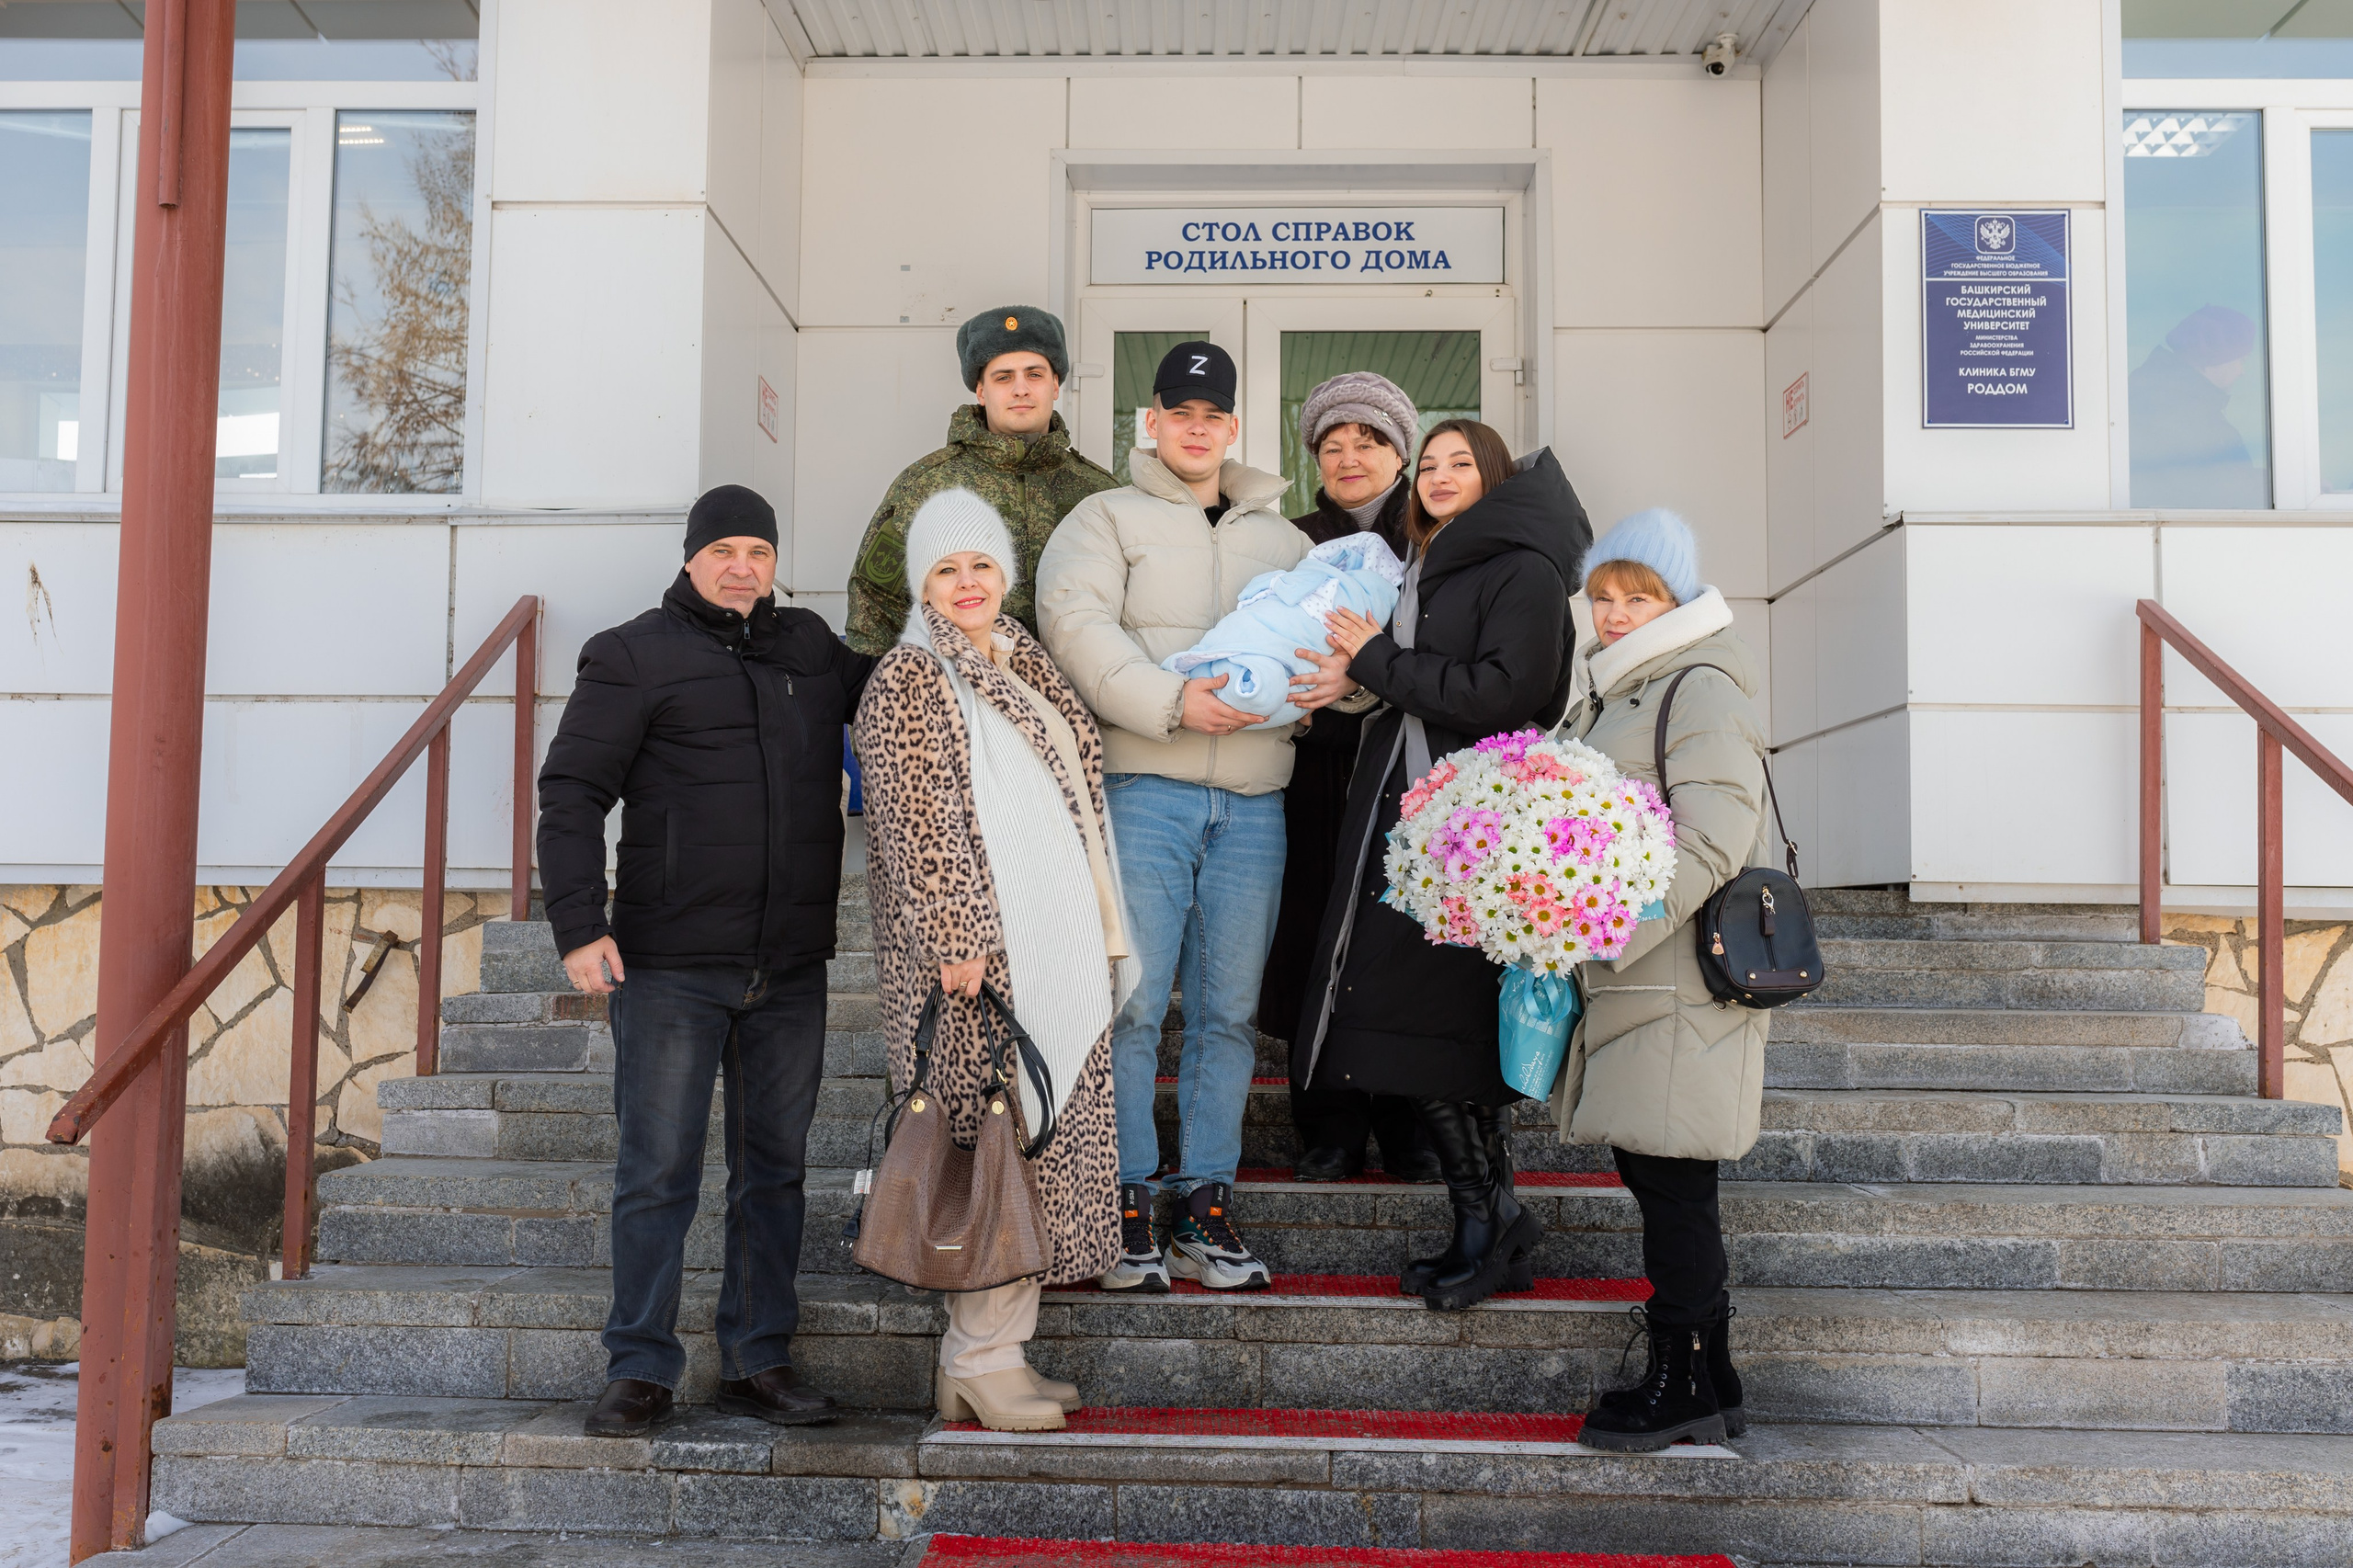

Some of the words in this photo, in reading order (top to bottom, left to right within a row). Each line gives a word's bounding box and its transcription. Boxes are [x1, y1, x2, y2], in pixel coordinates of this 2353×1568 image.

[1181, 222, 1263, 242] СТОЛ
[1271, 222, 1415, 242] СПРАВОК
[1145, 250, 1351, 273] РОДИЛЬНОГО
[1360, 250, 1452, 273] ДОМА
[1961, 284, 2031, 295] БАШКИРСКИЙ
[1946, 296, 2047, 308] ГОСУДАРСТВЕННЫЙ
[1957, 308, 2036, 319] МЕДИЦИНСКИЙ
[1963, 321, 2030, 331] УНИВЕРСИТЕТ
[1189, 355, 1209, 375] Z
[1959, 368, 2007, 377] КЛИНИКА
[2009, 368, 2037, 377] БГМУ
[1968, 383, 2029, 395] РОДДОМ
